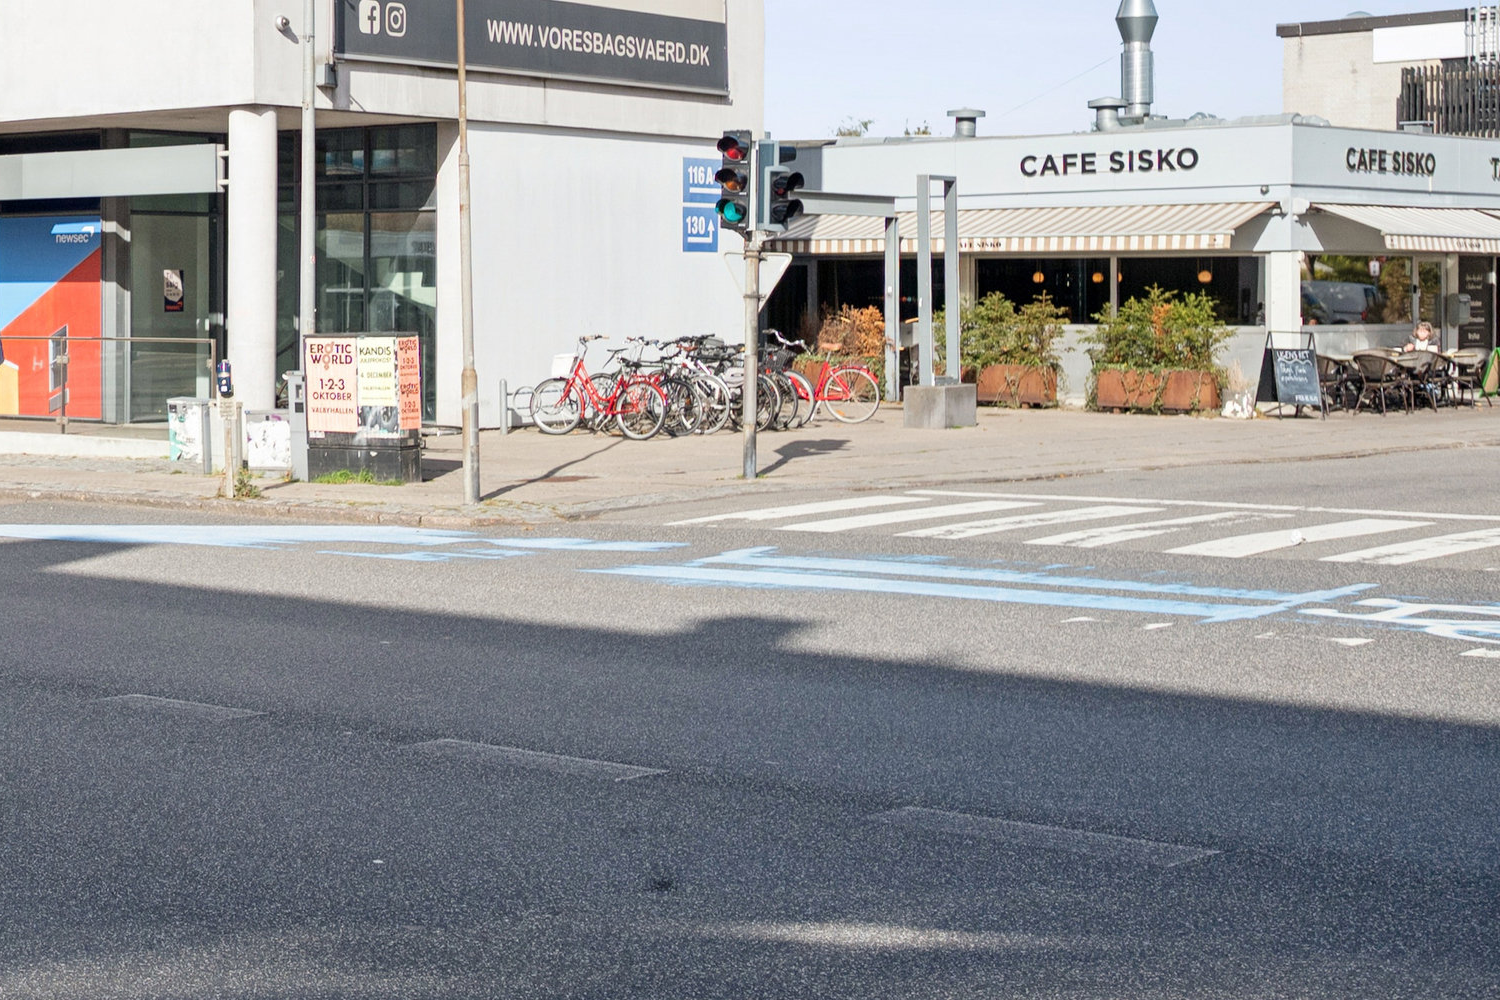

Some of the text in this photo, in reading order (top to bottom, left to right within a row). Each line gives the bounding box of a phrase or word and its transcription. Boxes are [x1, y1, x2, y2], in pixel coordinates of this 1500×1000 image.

[487, 18, 710, 66] WWW.VORESBAGSVAERD.DK
[1020, 147, 1199, 177] CAFE SISKO
[1346, 147, 1436, 176] CAFE SISKO
[687, 165, 715, 185] 116A
[686, 216, 706, 235] 130
[55, 233, 89, 243] newsec
[310, 342, 352, 354] EROTIC
[359, 346, 392, 356] KANDIS
[310, 354, 353, 365] WORLD
[319, 378, 345, 390] 1-2-3
[312, 391, 352, 400] OKTOBER
